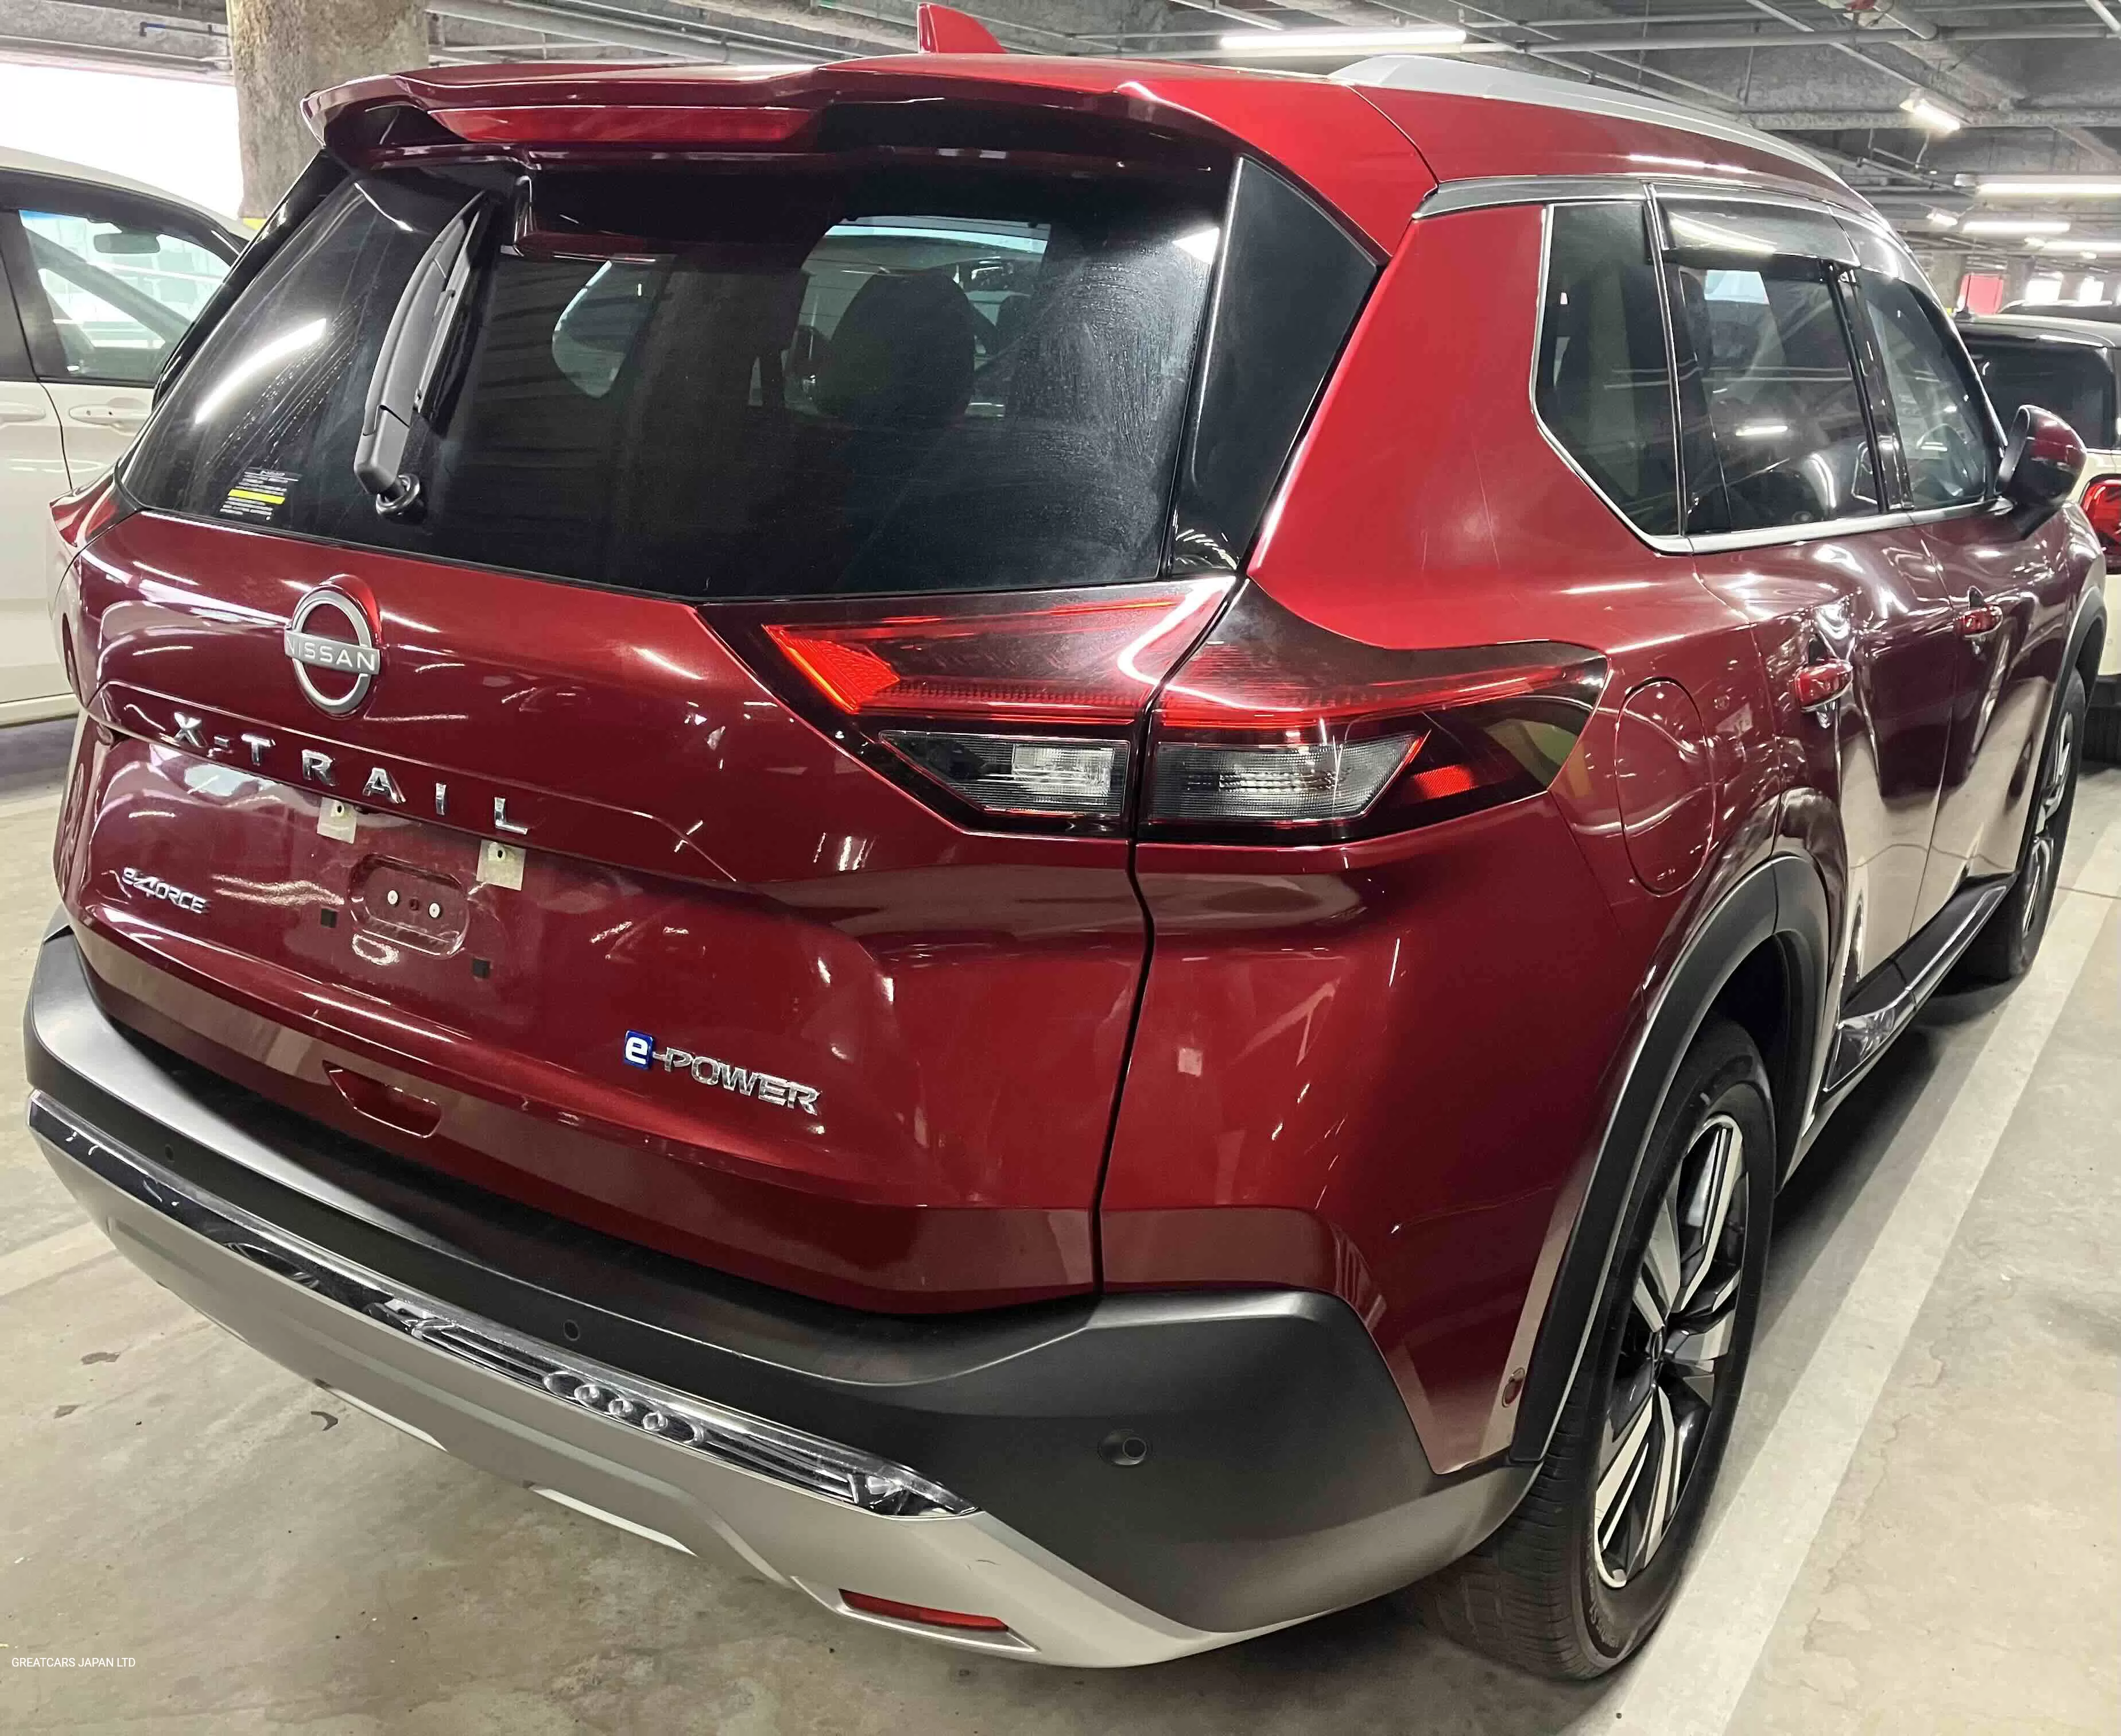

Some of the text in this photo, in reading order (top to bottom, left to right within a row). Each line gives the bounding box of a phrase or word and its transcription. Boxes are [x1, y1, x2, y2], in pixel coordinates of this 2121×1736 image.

[286, 636, 375, 672] NISSAN
[173, 712, 528, 835] X-TRAIL
[625, 1036, 822, 1115] e-POWER
